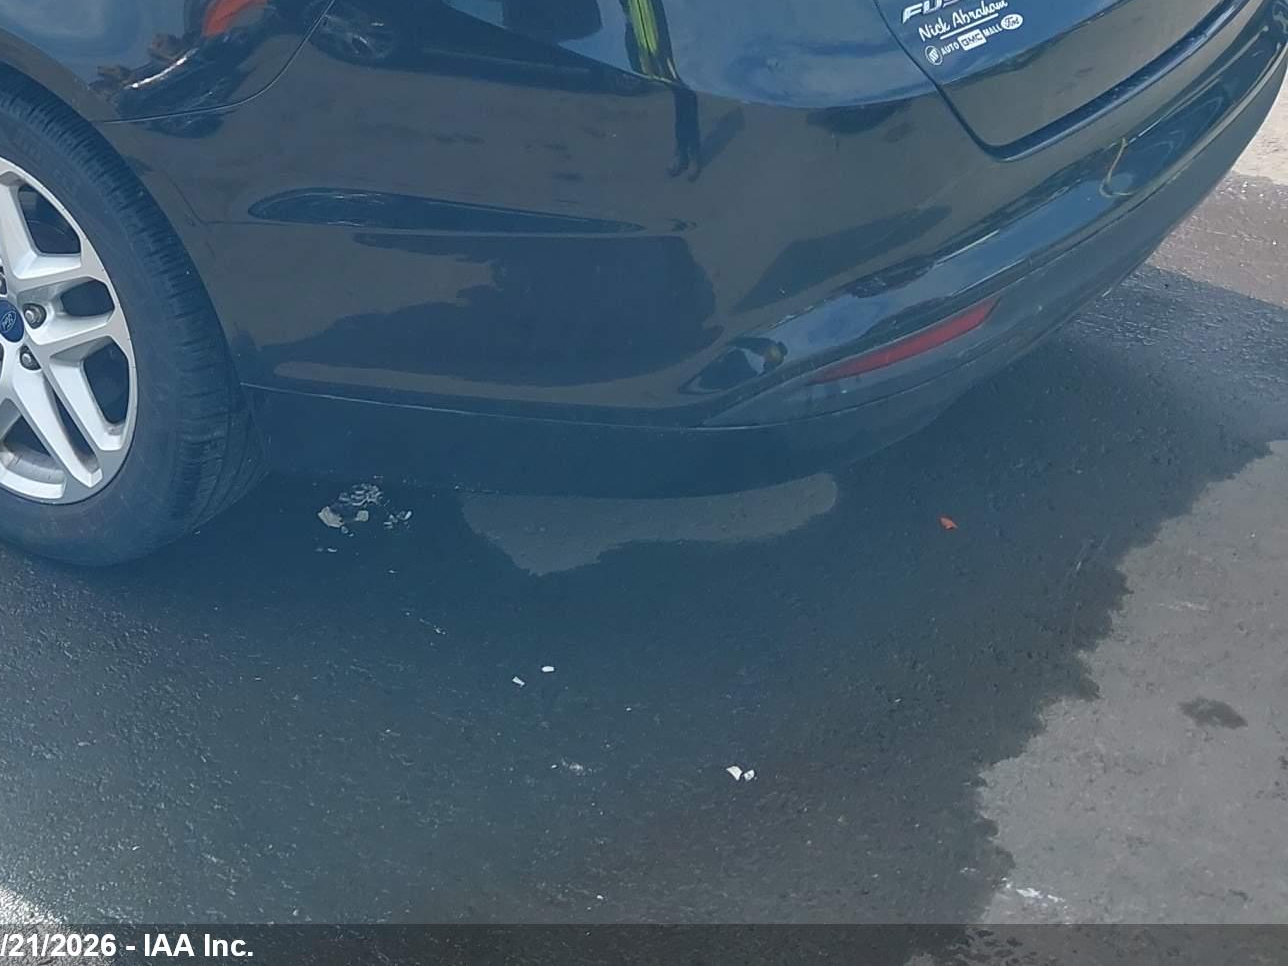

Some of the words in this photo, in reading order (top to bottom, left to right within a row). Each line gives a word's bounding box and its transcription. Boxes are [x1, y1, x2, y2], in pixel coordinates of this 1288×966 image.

[918, 17, 951, 42] Nick
[952, 0, 1008, 28] Abraham
[941, 42, 960, 56] AUTO
[960, 32, 985, 48] GMC
[983, 24, 1002, 38] MALL
